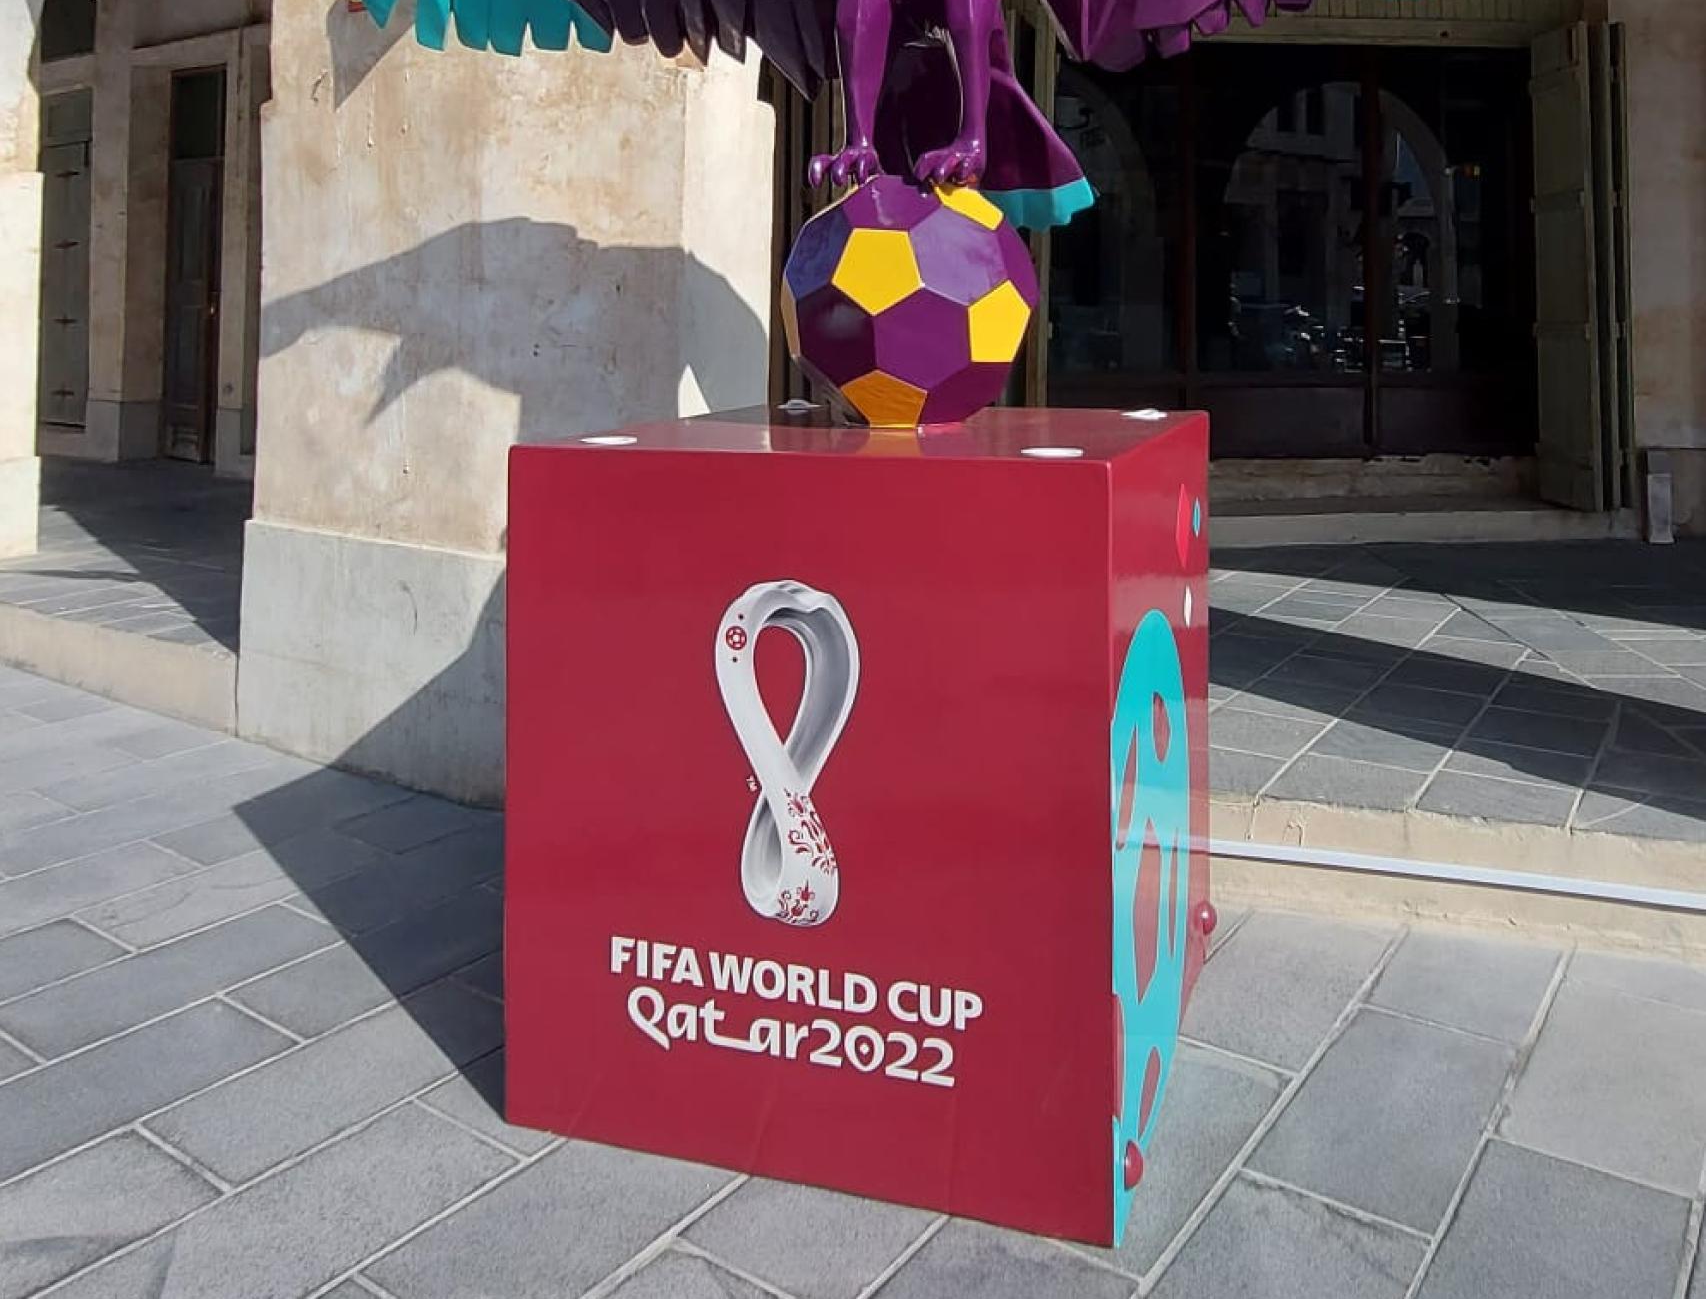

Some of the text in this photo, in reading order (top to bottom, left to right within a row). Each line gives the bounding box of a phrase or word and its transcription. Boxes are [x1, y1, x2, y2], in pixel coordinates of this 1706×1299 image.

[610, 936, 983, 1031] FIFA WORLD CUP
